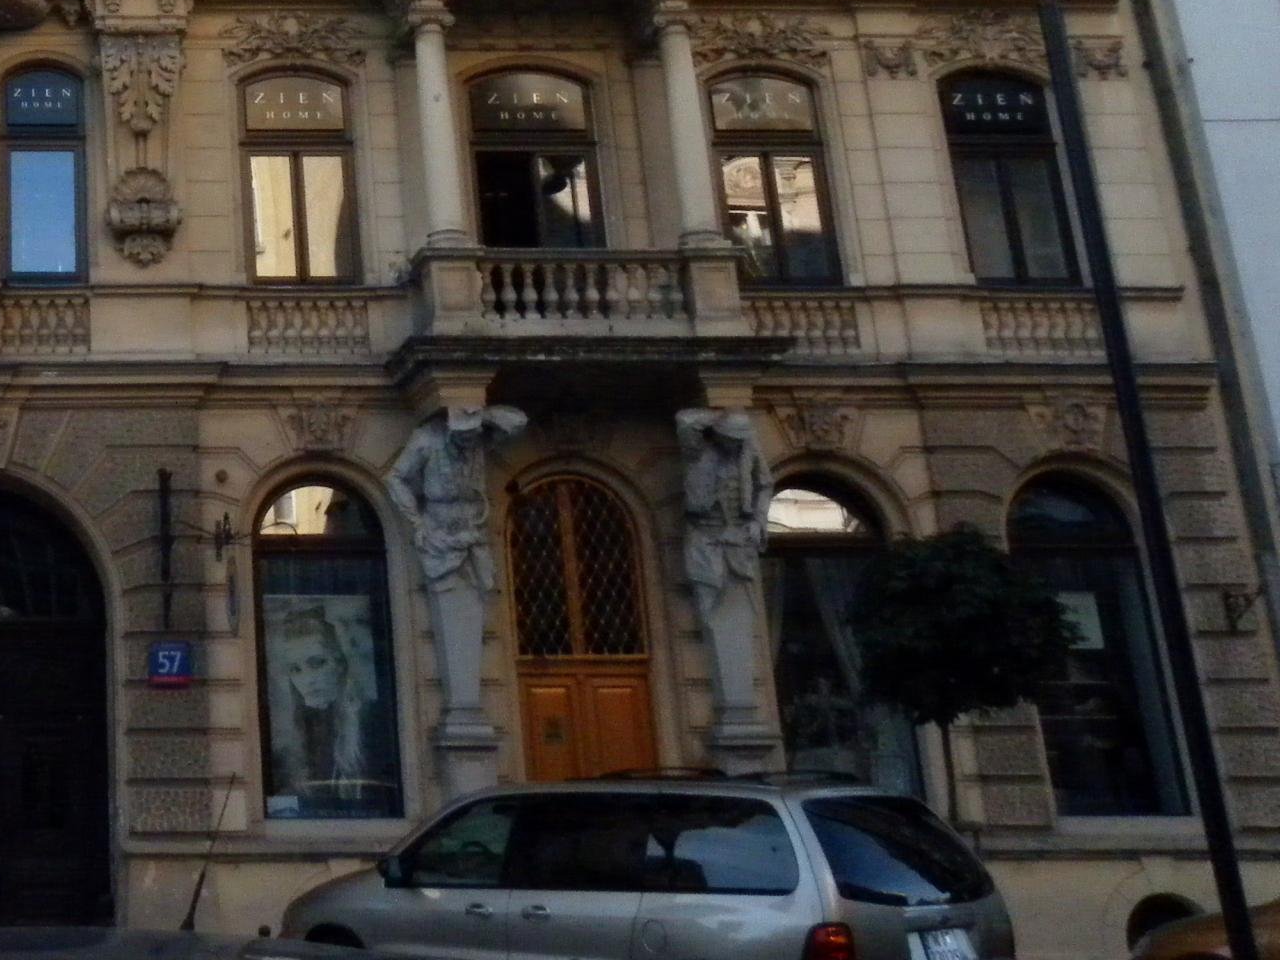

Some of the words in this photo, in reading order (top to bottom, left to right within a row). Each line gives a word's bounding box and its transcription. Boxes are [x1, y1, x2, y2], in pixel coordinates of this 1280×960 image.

[500, 111, 559, 120] HOME
[964, 111, 1024, 121] HOME
[158, 650, 181, 674] 57
